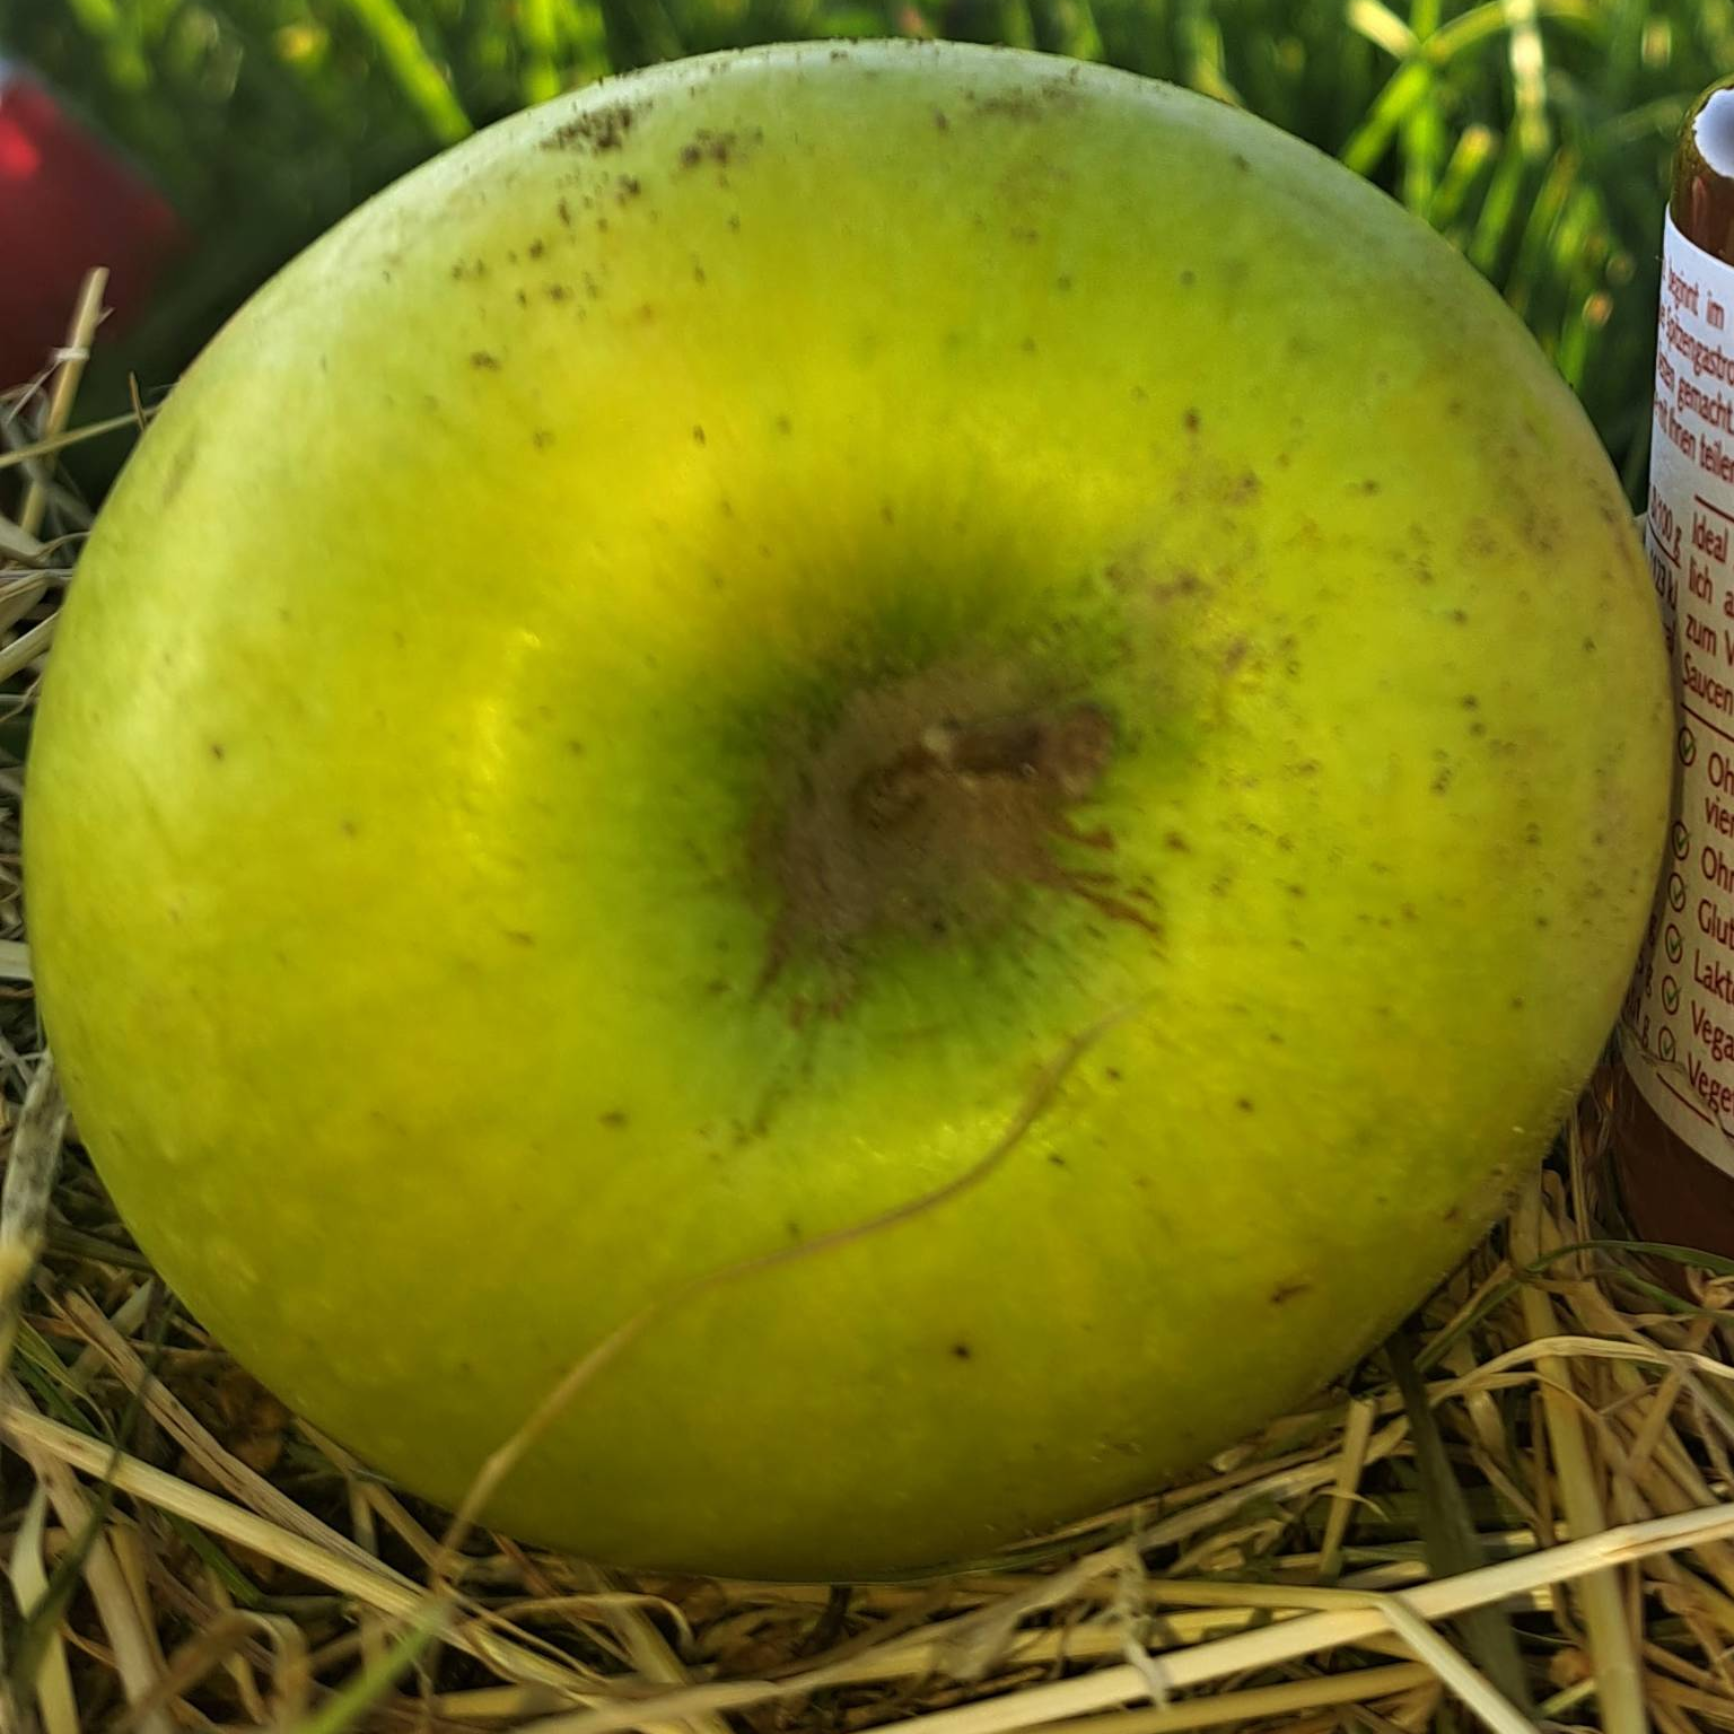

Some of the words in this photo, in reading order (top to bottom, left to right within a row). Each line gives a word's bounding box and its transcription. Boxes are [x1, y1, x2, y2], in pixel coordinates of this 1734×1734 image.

[1707, 290, 1724, 330] im
[1692, 512, 1729, 563] Ideal
[1689, 556, 1713, 604] lich
[1686, 614, 1717, 656] zum
[1683, 653, 1734, 716] Saucen
